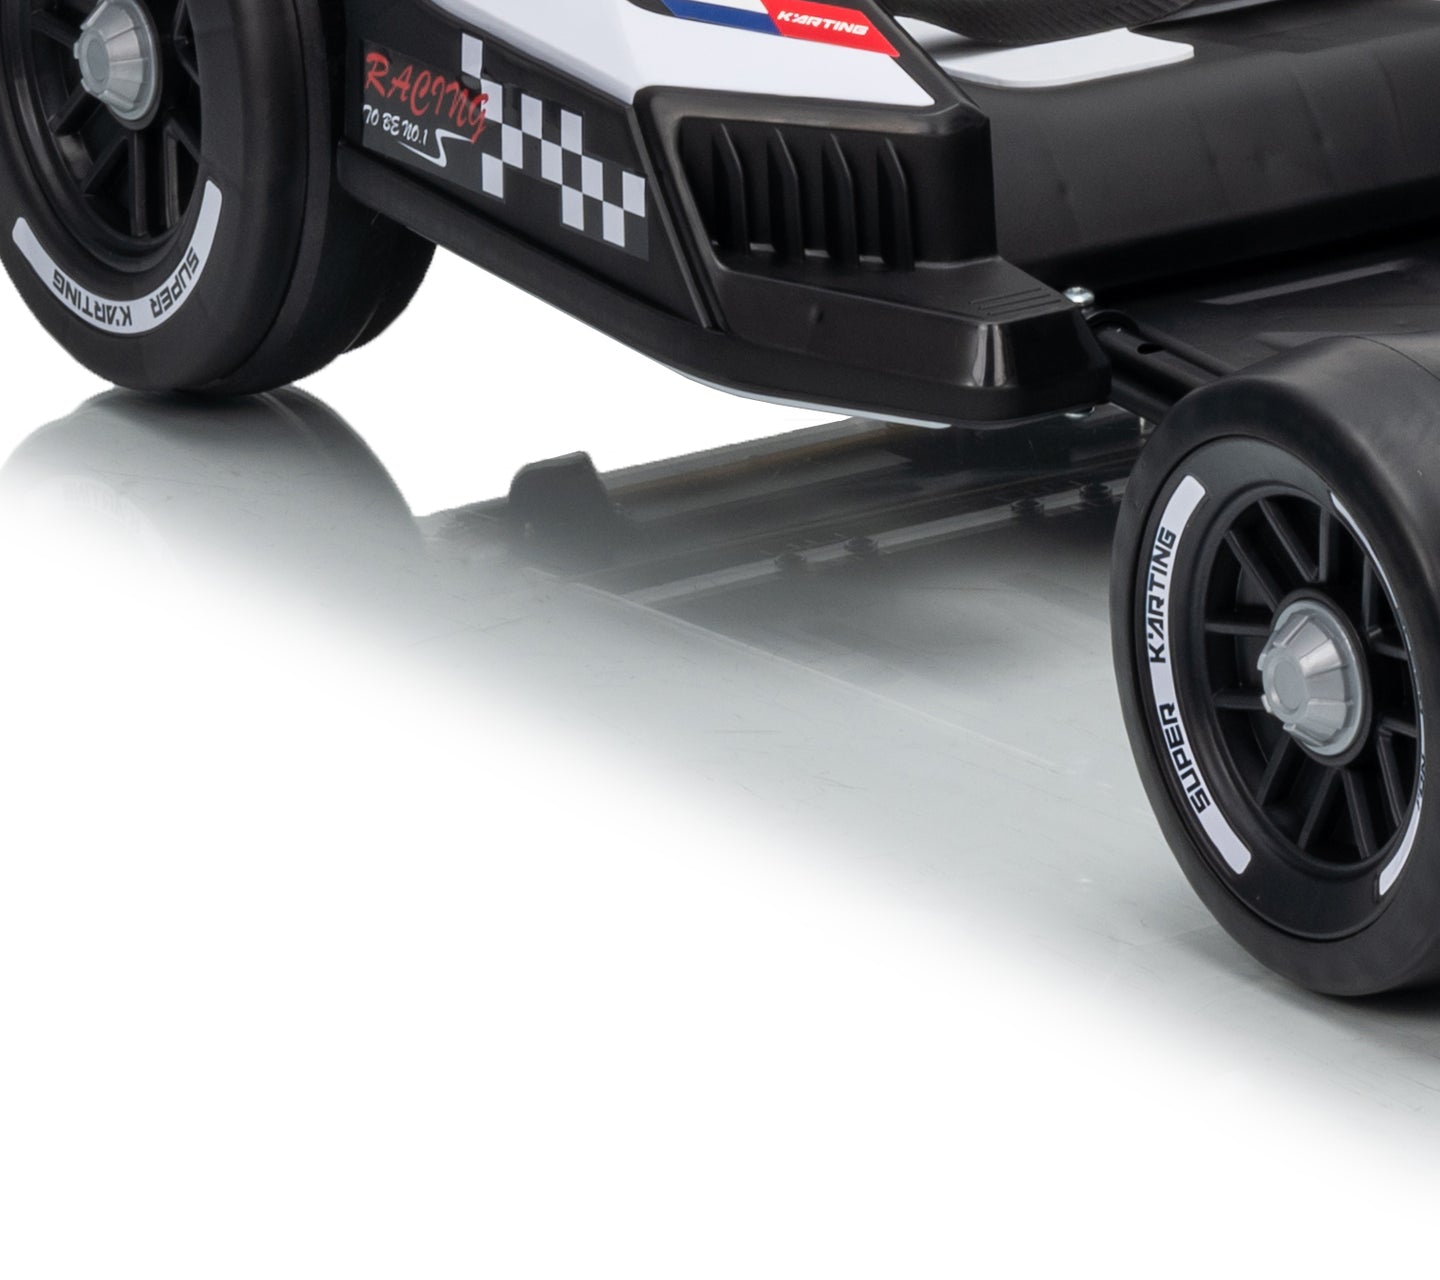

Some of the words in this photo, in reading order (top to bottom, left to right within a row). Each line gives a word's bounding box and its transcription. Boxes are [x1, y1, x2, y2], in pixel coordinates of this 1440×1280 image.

[363, 104, 379, 126] TO
[382, 112, 401, 136] BE
[365, 52, 488, 144] RACING
[150, 246, 200, 318] SUPER
[1159, 703, 1211, 813] SUPER
